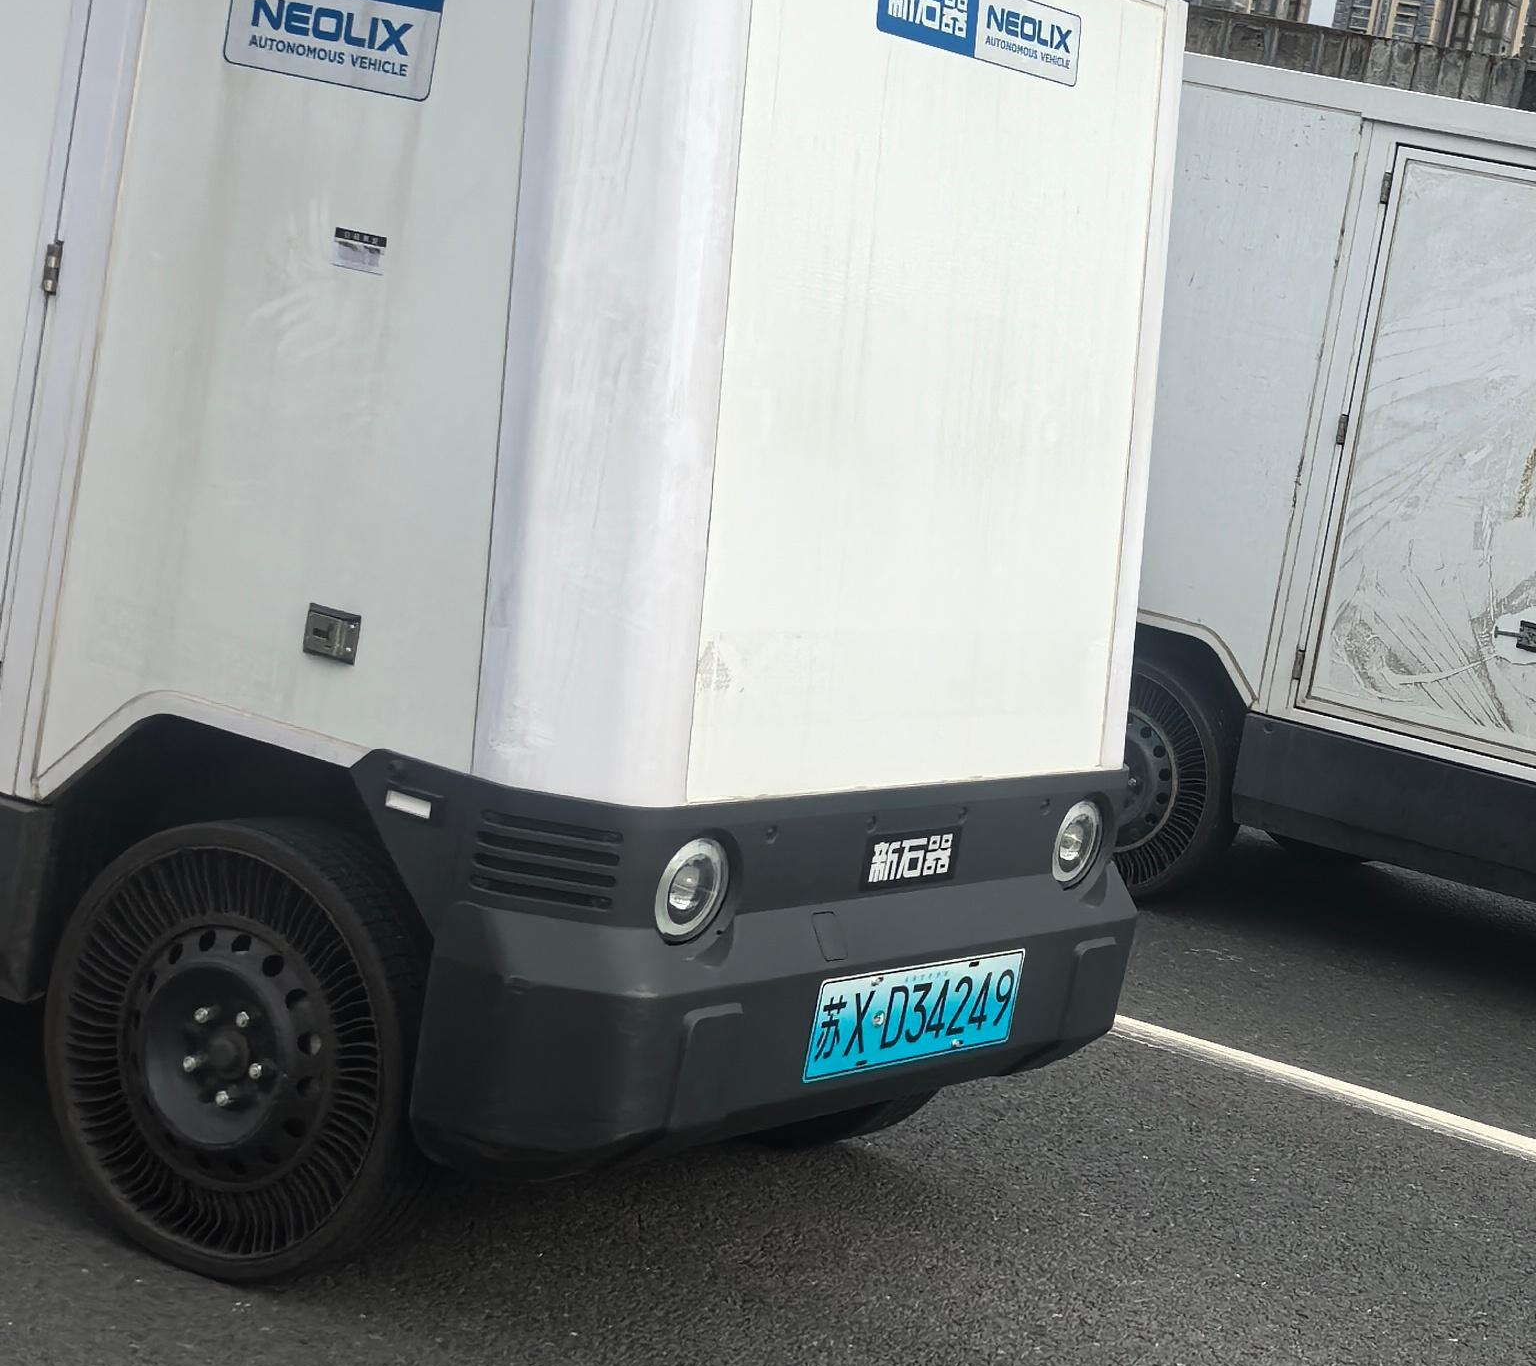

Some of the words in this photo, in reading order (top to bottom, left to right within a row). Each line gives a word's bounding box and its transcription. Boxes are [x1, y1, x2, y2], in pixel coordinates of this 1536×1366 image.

[986, 4, 1073, 54] NEOLIX
[248, 34, 345, 65] AUTONOMOUS
[350, 54, 408, 77] VEHICLE
[985, 35, 1038, 60] AUTONOMOUS
[1040, 51, 1071, 70] VEHICLE
[868, 833, 954, 883] 新石器
